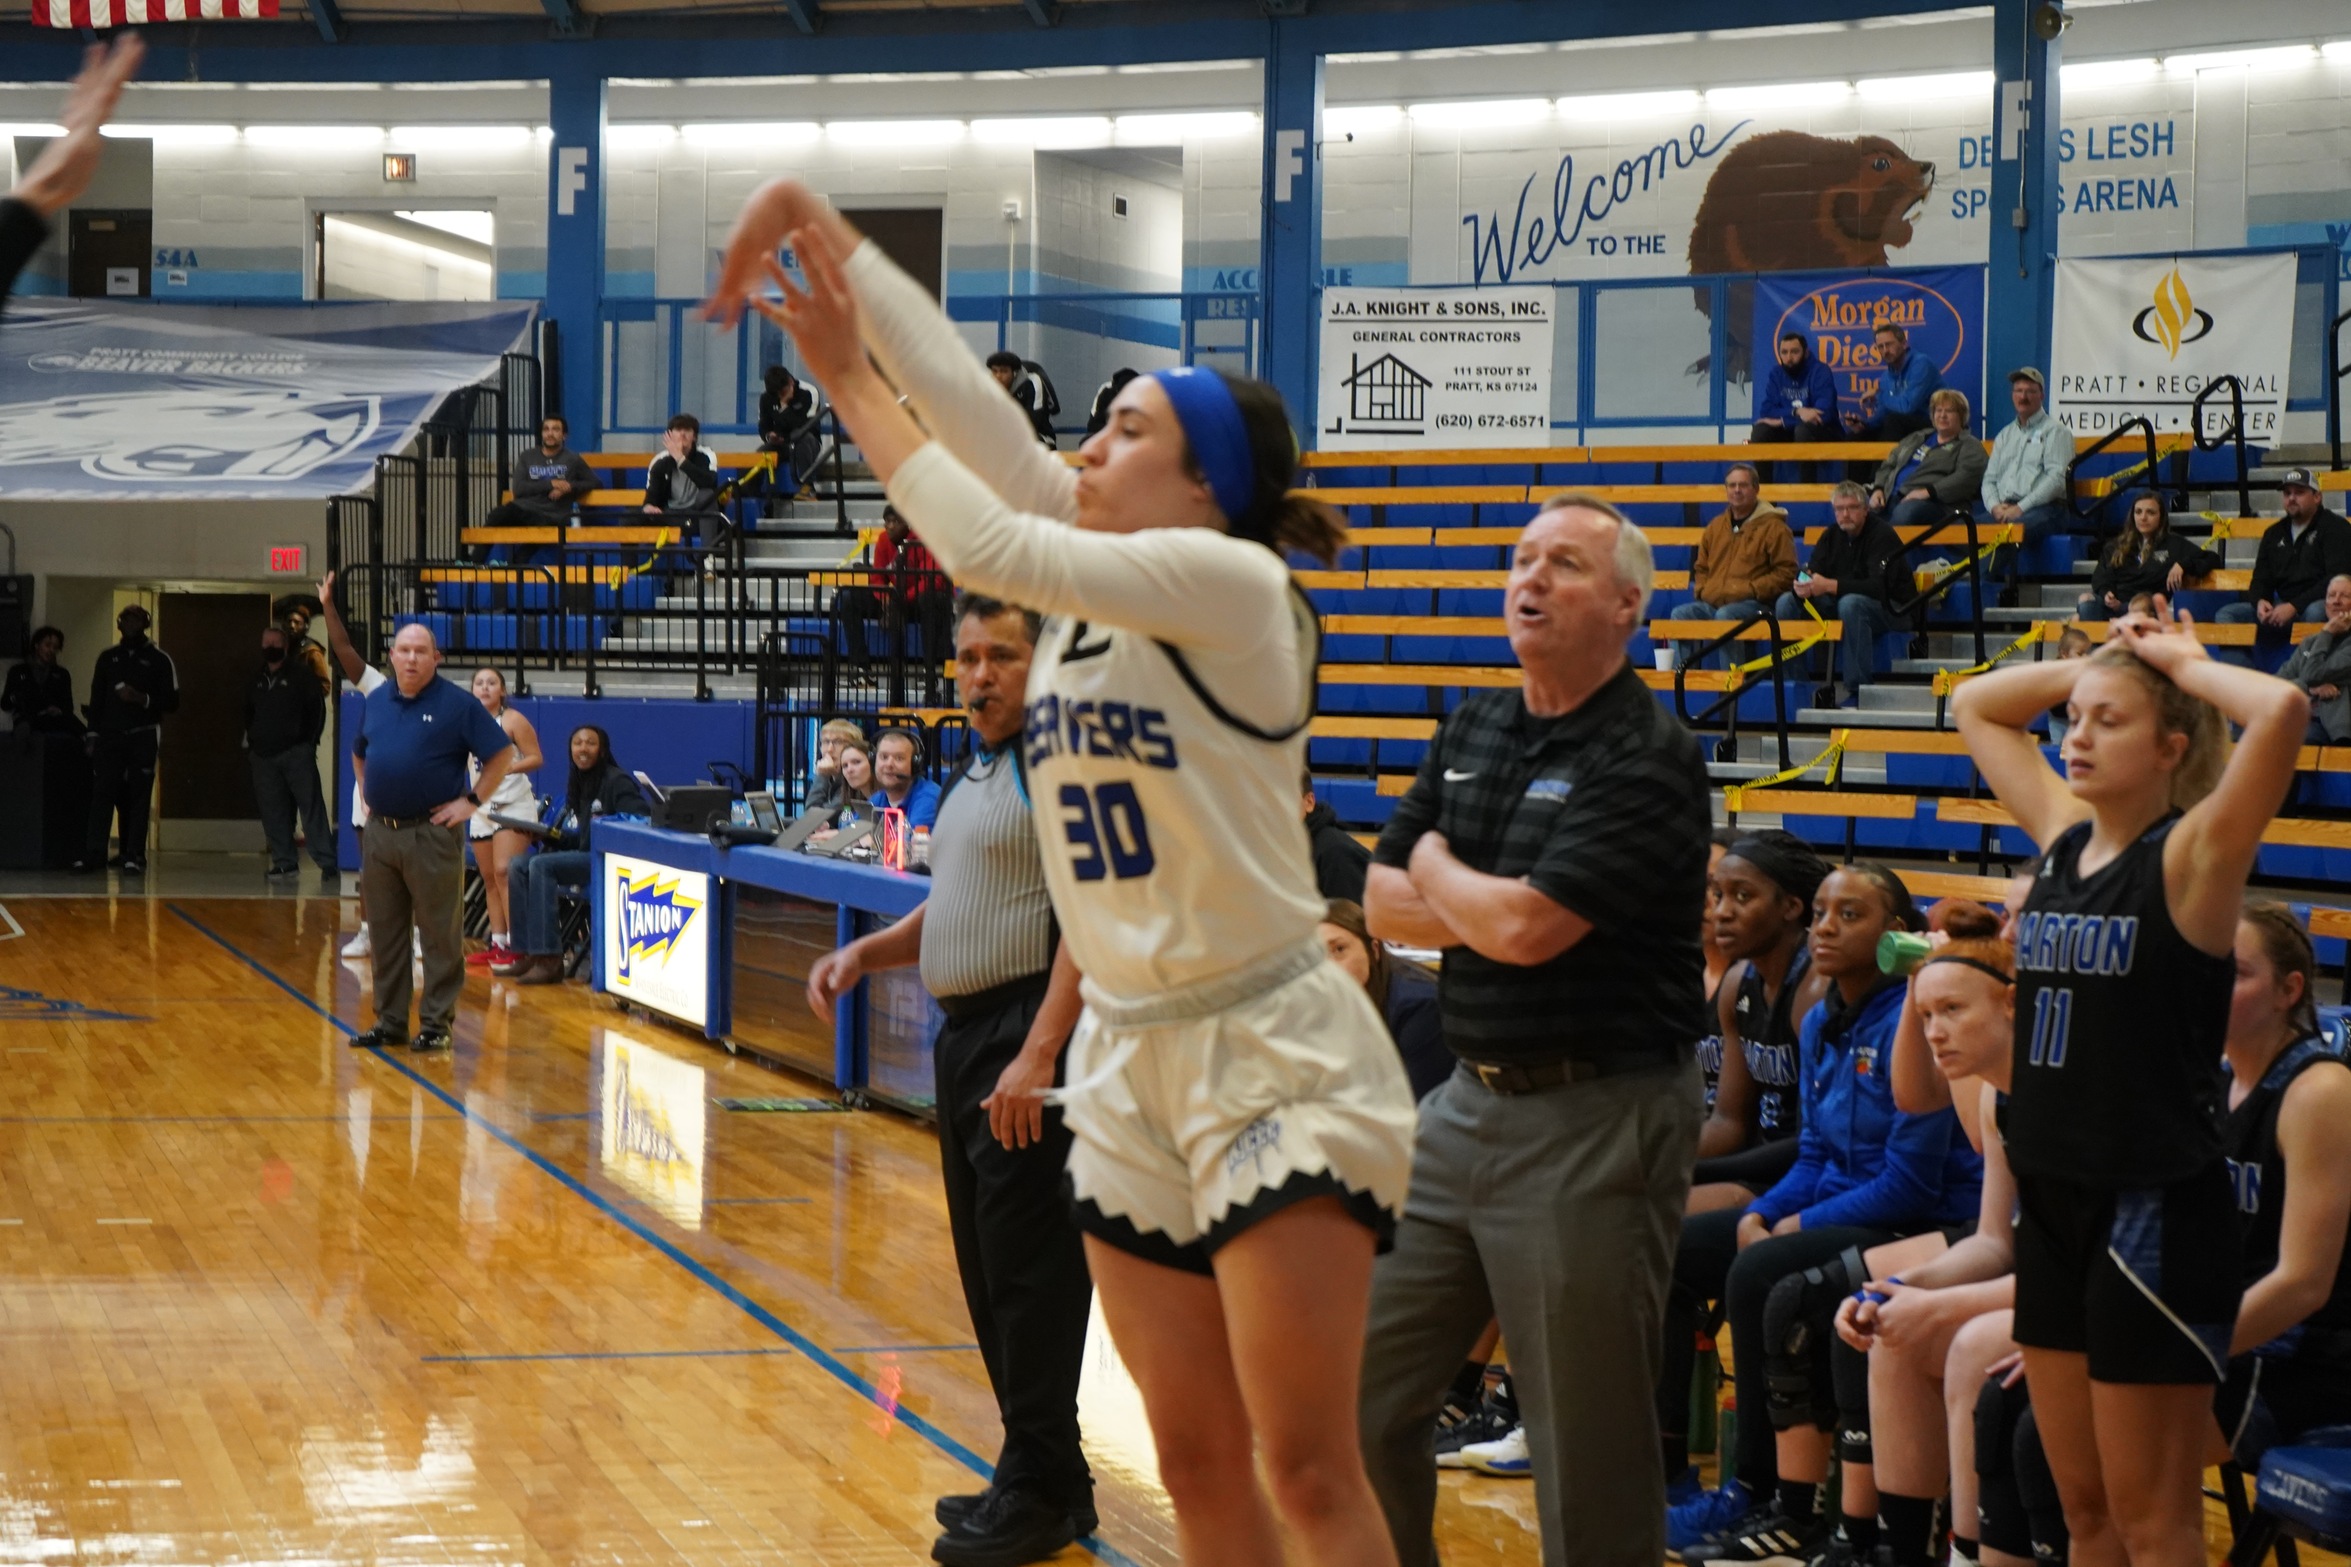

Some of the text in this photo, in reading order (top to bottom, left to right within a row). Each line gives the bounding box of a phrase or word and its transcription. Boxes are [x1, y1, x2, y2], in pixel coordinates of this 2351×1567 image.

[2000, 80, 2032, 161] F
[1960, 120, 2174, 170] DES LESH
[557, 147, 587, 215] F
[1275, 130, 1304, 202] F
[1463, 119, 1754, 284] Welcome
[2073, 177, 2179, 214] ARENA
[1587, 235, 1666, 256] TO THE
[1331, 301, 1546, 317] J.A. KNIGHT & SONS, INC.
[1811, 294, 1926, 331] Morgan
[1353, 331, 1521, 343] GENERAL CONTRACTORS
[1445, 382, 1538, 393] PRATT, KS 67124
[1454, 367, 1531, 376] 111 STOUT ST
[2061, 374, 2278, 394] PRATT REGIONAL
[1435, 414, 1544, 429] (620) 672-6571
[2059, 412, 2162, 430] MEDICL
[271, 547, 301, 572] EXIT
[1058, 781, 1155, 881] 30
[618, 881, 682, 971] STANION
[2016, 911, 2139, 977] ARTON
[2029, 986, 2074, 1069] 11
